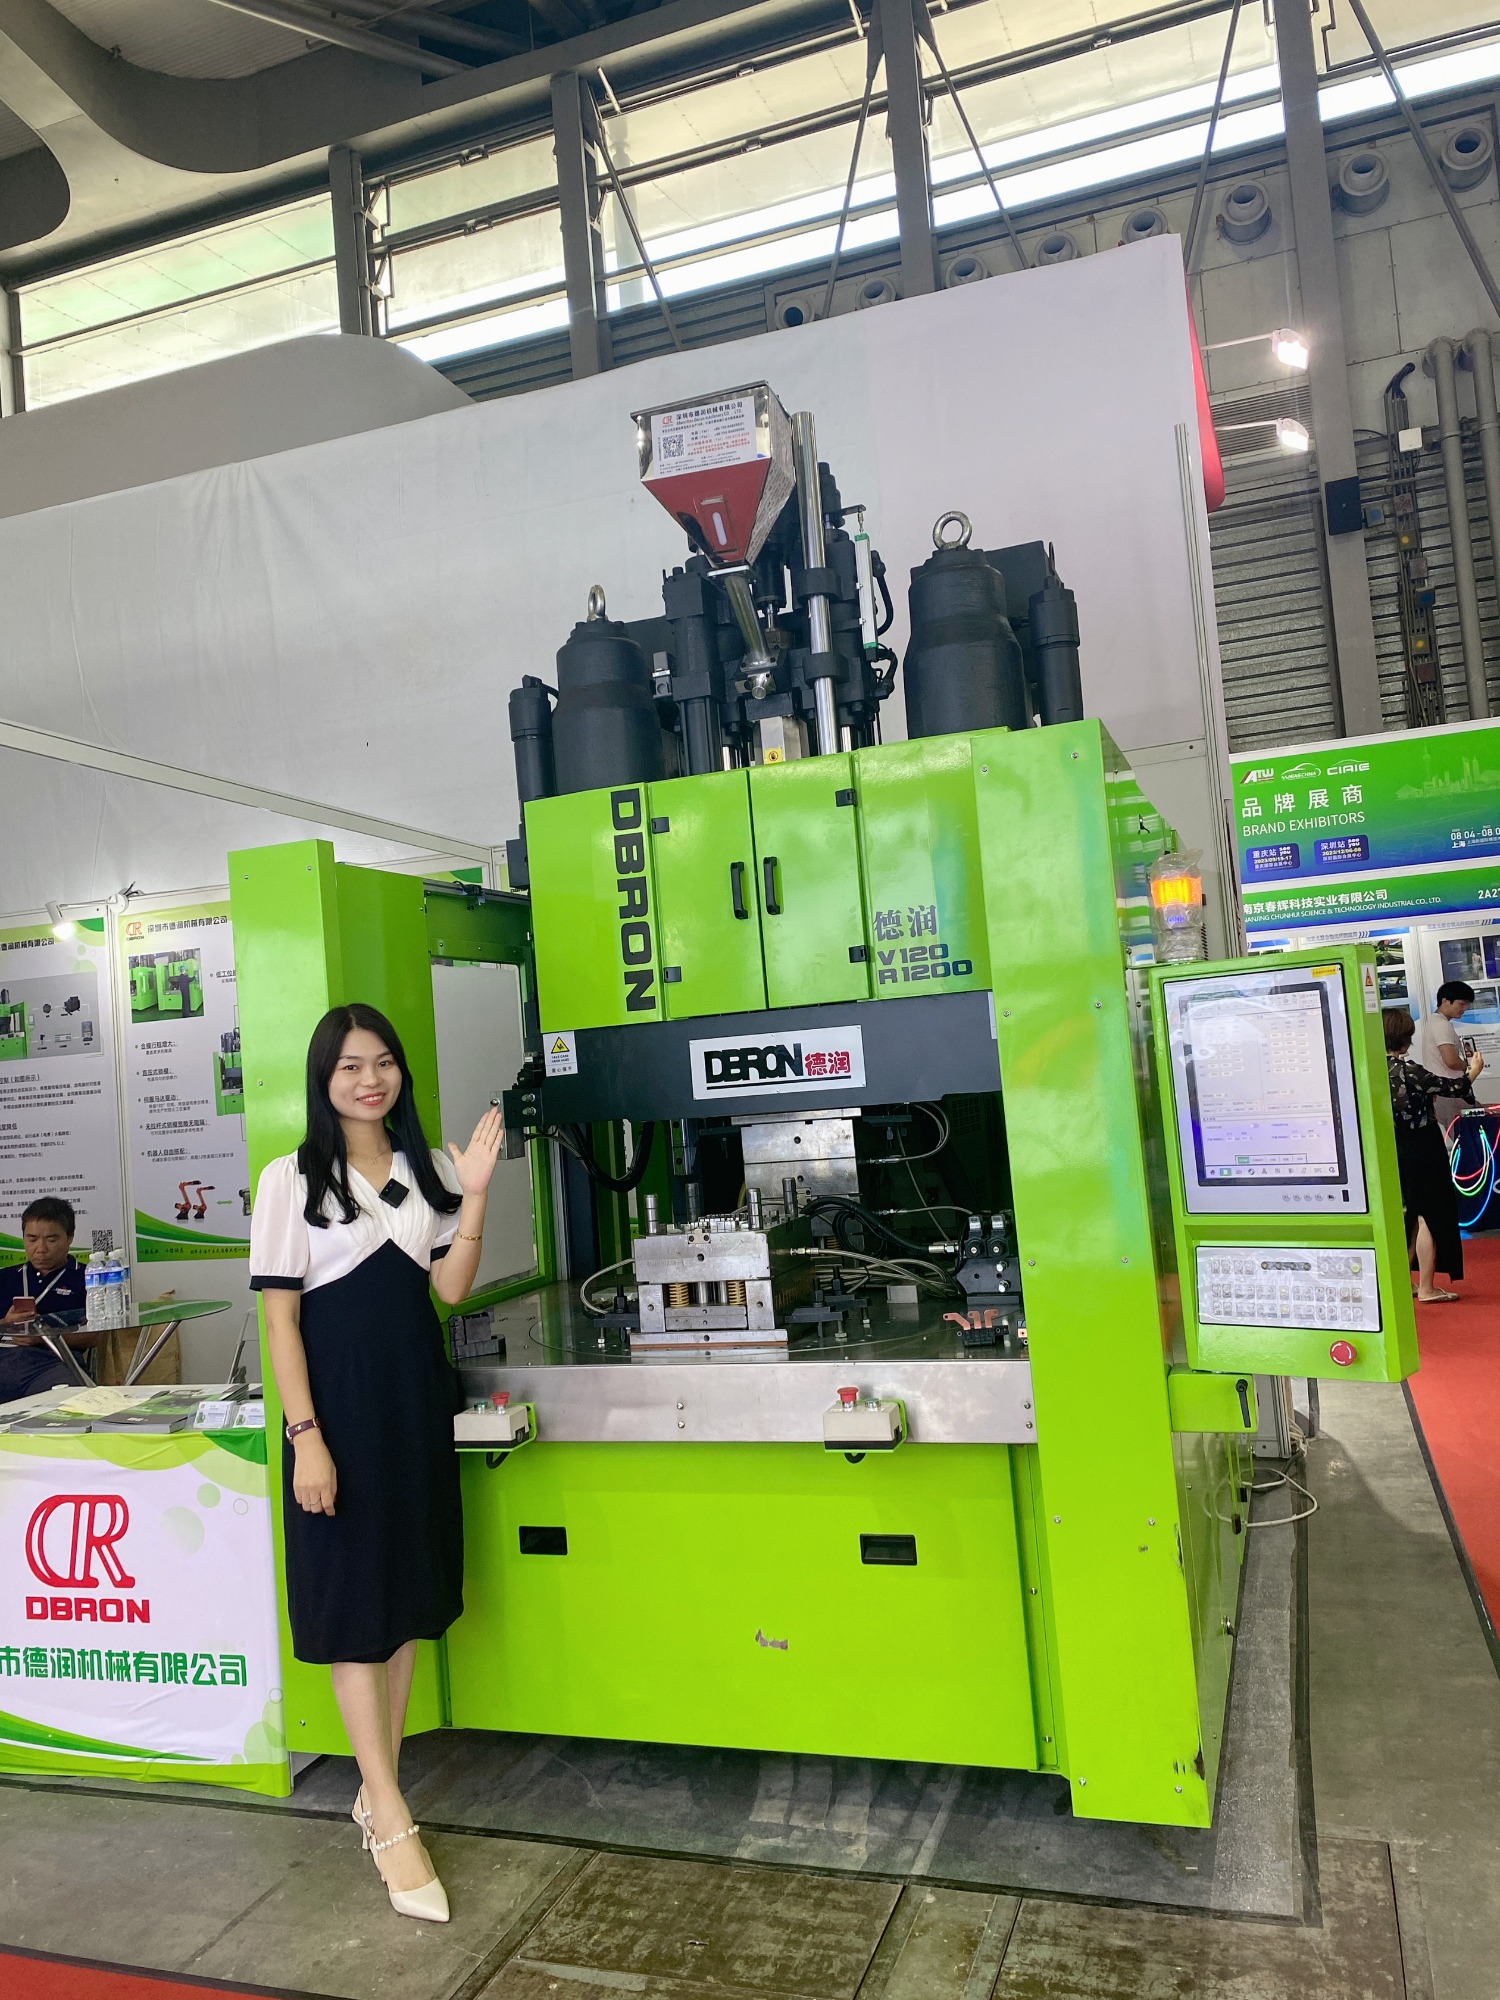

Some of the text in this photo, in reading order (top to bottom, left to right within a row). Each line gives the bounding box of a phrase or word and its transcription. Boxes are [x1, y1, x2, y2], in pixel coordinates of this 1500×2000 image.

[1242, 784, 1363, 818] 品牌展商
[1243, 812, 1365, 836] BRAND EXHIBITORS
[1450, 832, 1462, 840] 08
[1252, 848, 1276, 858] 重庆站
[1320, 840, 1346, 850] 深圳站
[1452, 840, 1466, 848] 上海
[610, 788, 656, 1012] DBRON
[1244, 889, 1388, 914] 南京春辉科技实业有限公司
[1271, 911, 1300, 920] CHUNHUI
[1301, 909, 1326, 917] SCIENCE
[1334, 903, 1376, 914] TECHNOLOGY
[1378, 898, 1414, 908] INDUSTRIAL
[873, 904, 938, 942] 德润
[704, 1043, 851, 1084] DBRON 德润
[26, 1596, 150, 1624] DBRON
[0, 1646, 248, 1686] 市德润机械有限公司
